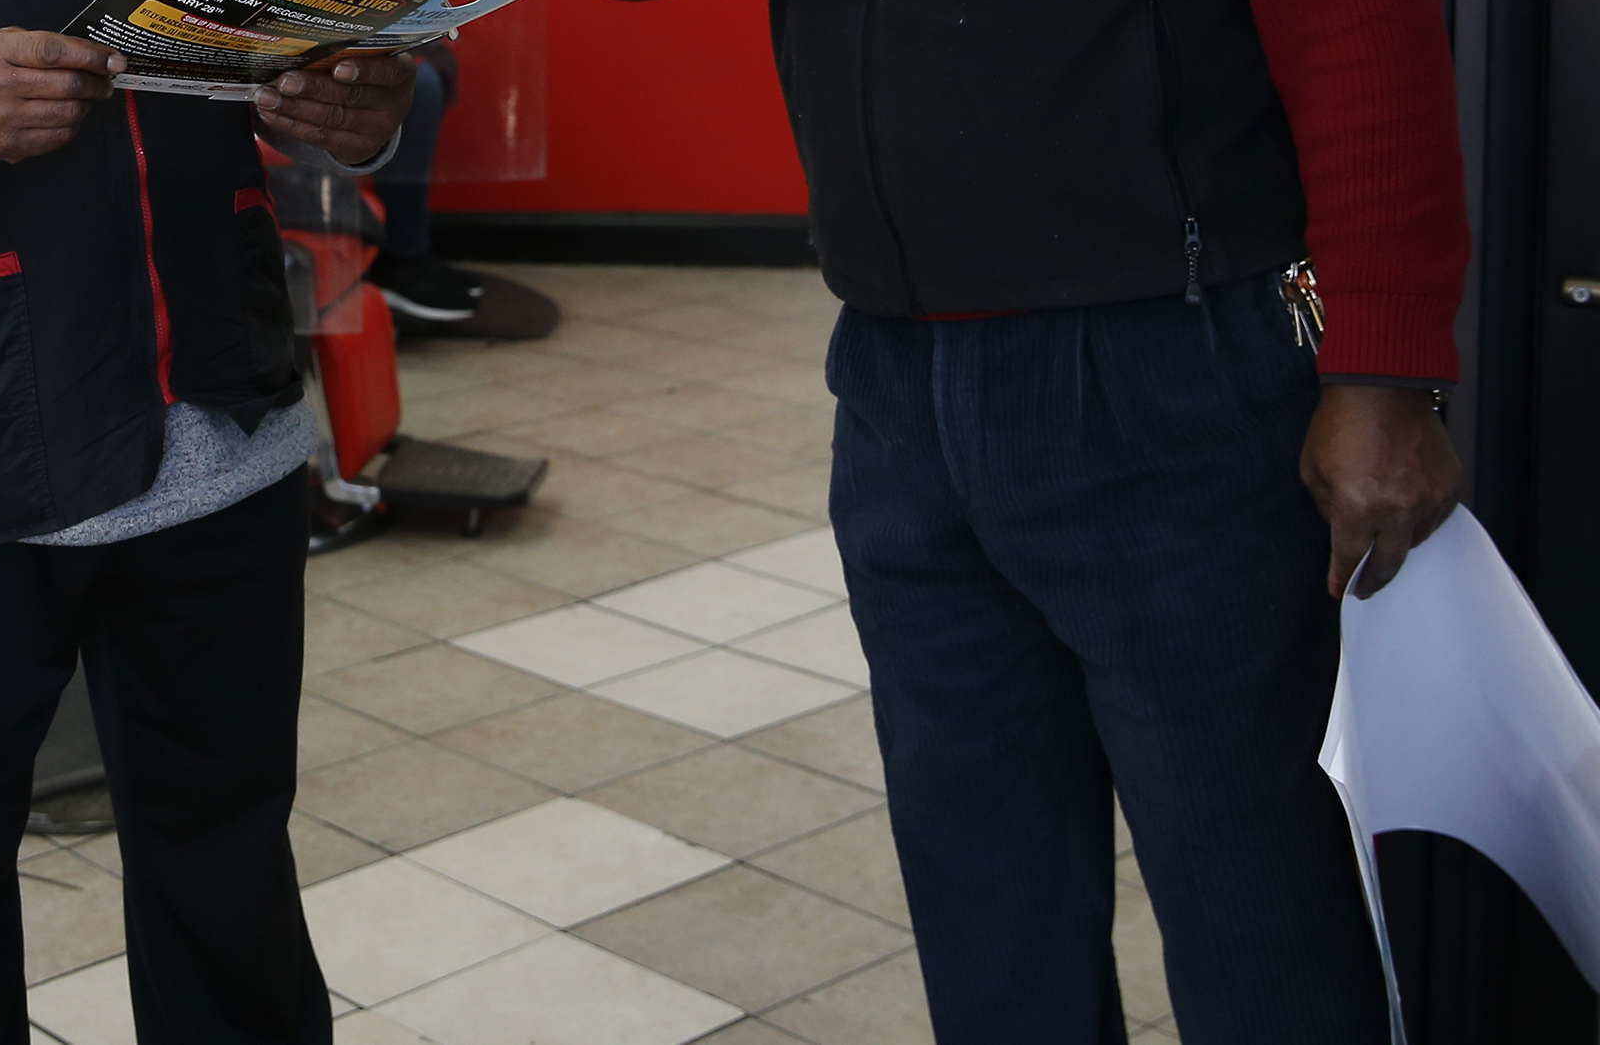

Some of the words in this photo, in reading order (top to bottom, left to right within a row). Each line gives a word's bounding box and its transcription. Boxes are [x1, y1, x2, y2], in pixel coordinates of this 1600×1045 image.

[200, 4, 225, 14] 28TH
[182, 15, 199, 24] SIGN
[205, 22, 220, 30] FOR
[266, 5, 304, 20] REGGIE
[303, 14, 337, 26] LEWIS
[334, 21, 374, 32] CENTER
